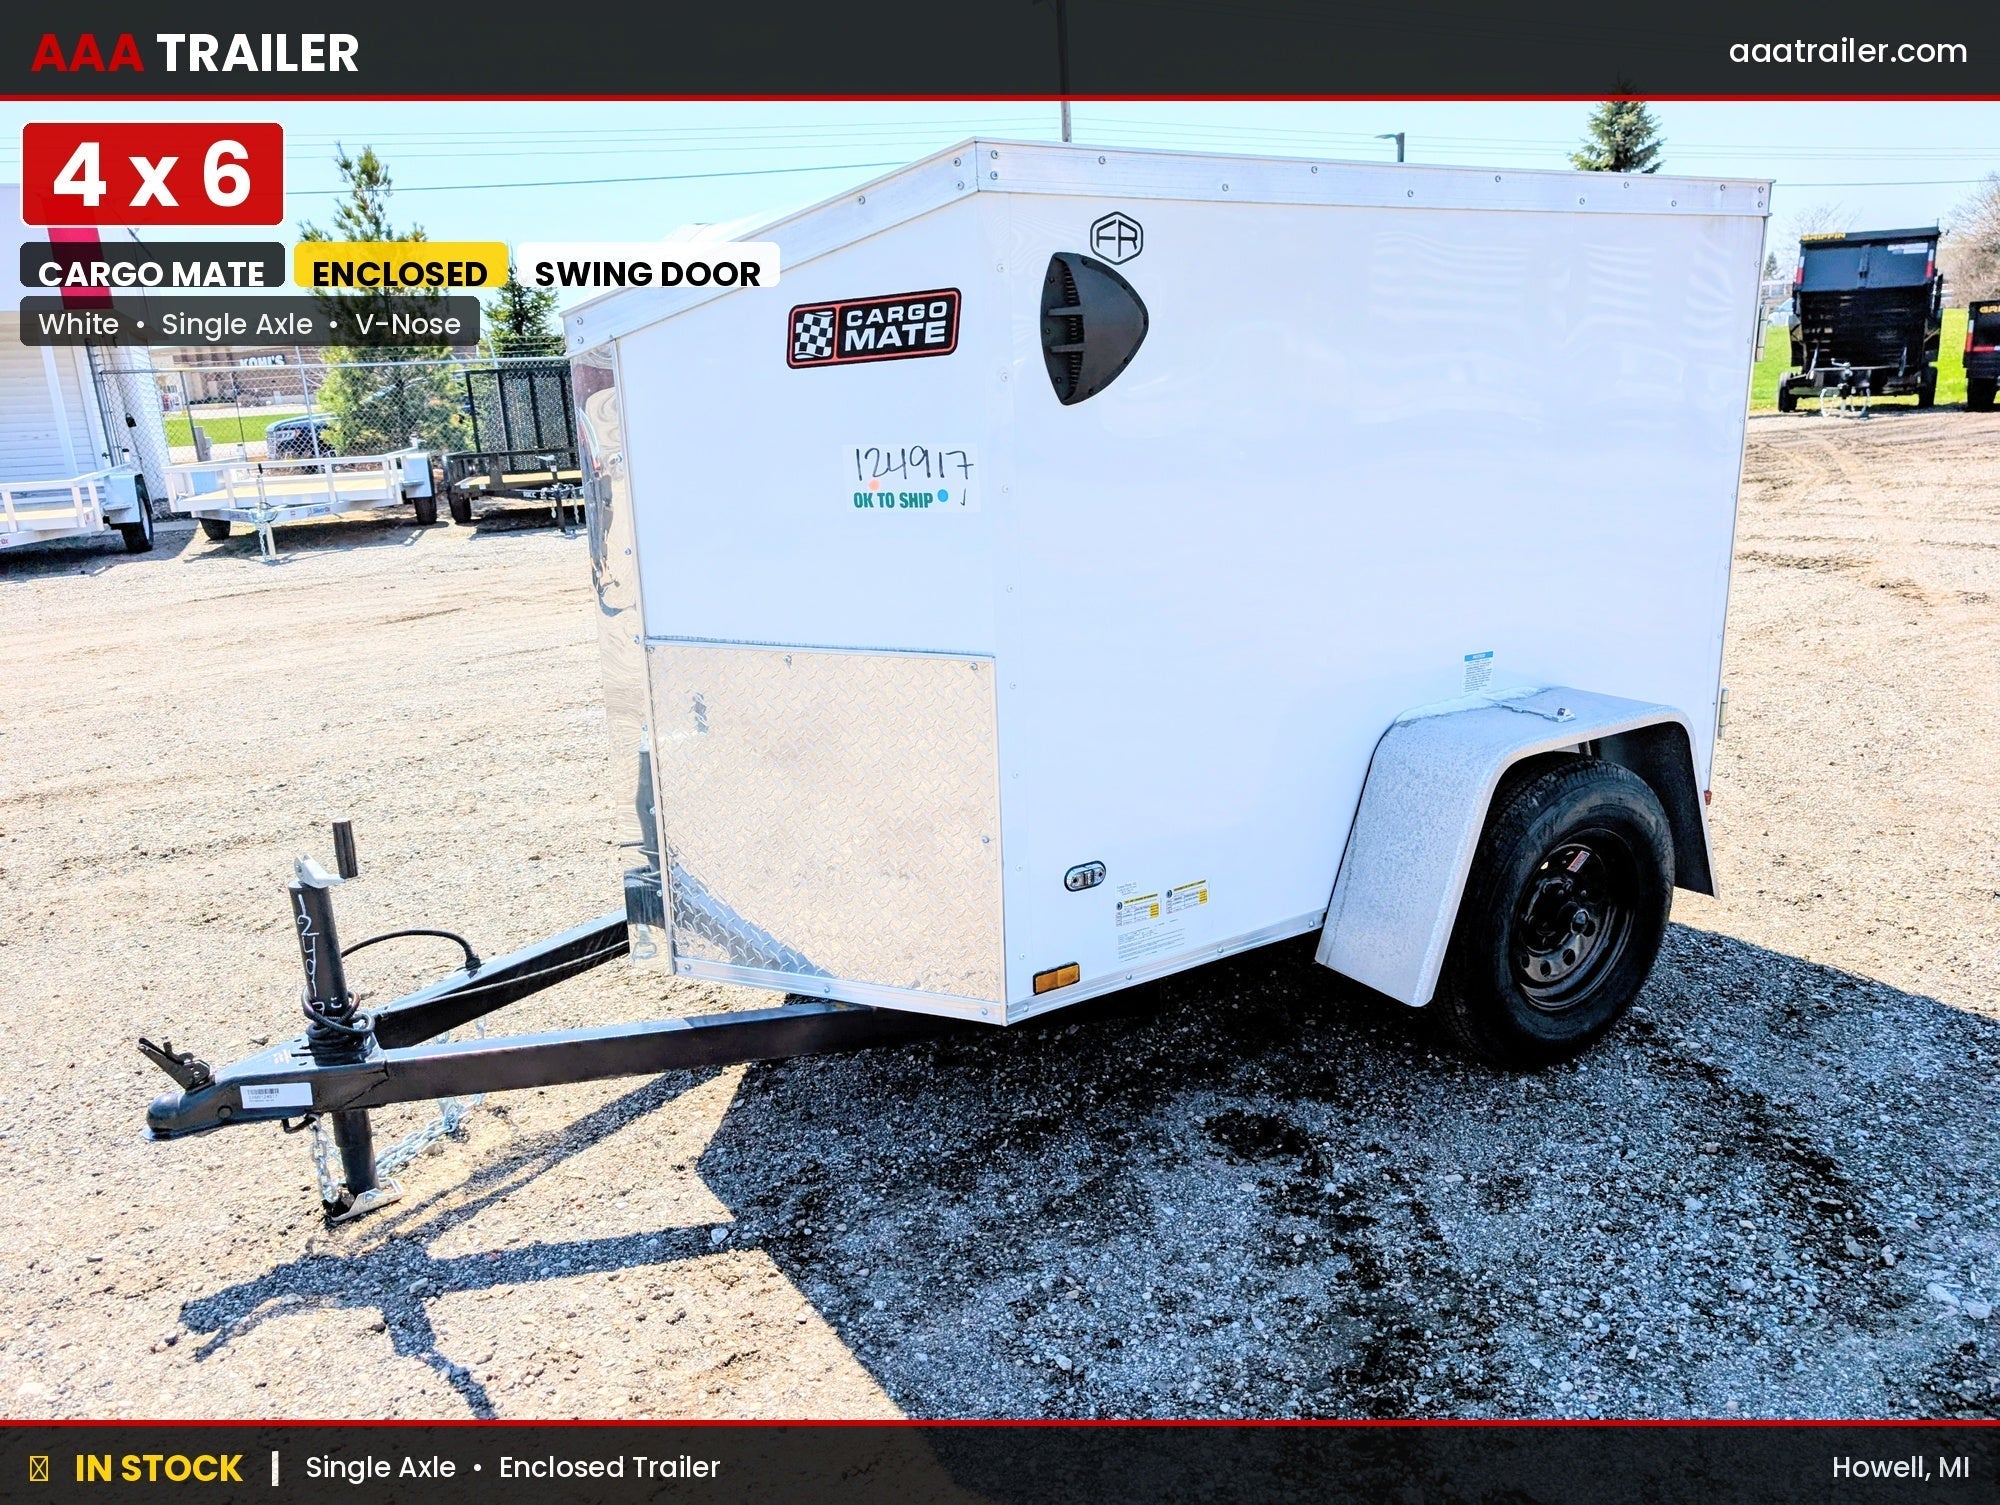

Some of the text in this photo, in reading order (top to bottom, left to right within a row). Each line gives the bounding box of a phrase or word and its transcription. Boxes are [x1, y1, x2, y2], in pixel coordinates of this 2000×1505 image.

[846, 301, 947, 326] CARGO
[845, 321, 947, 351] MATE
[240, 355, 285, 366] KOHL'S
[855, 445, 975, 482] 124917
[853, 492, 934, 509] OK TO SHIP
